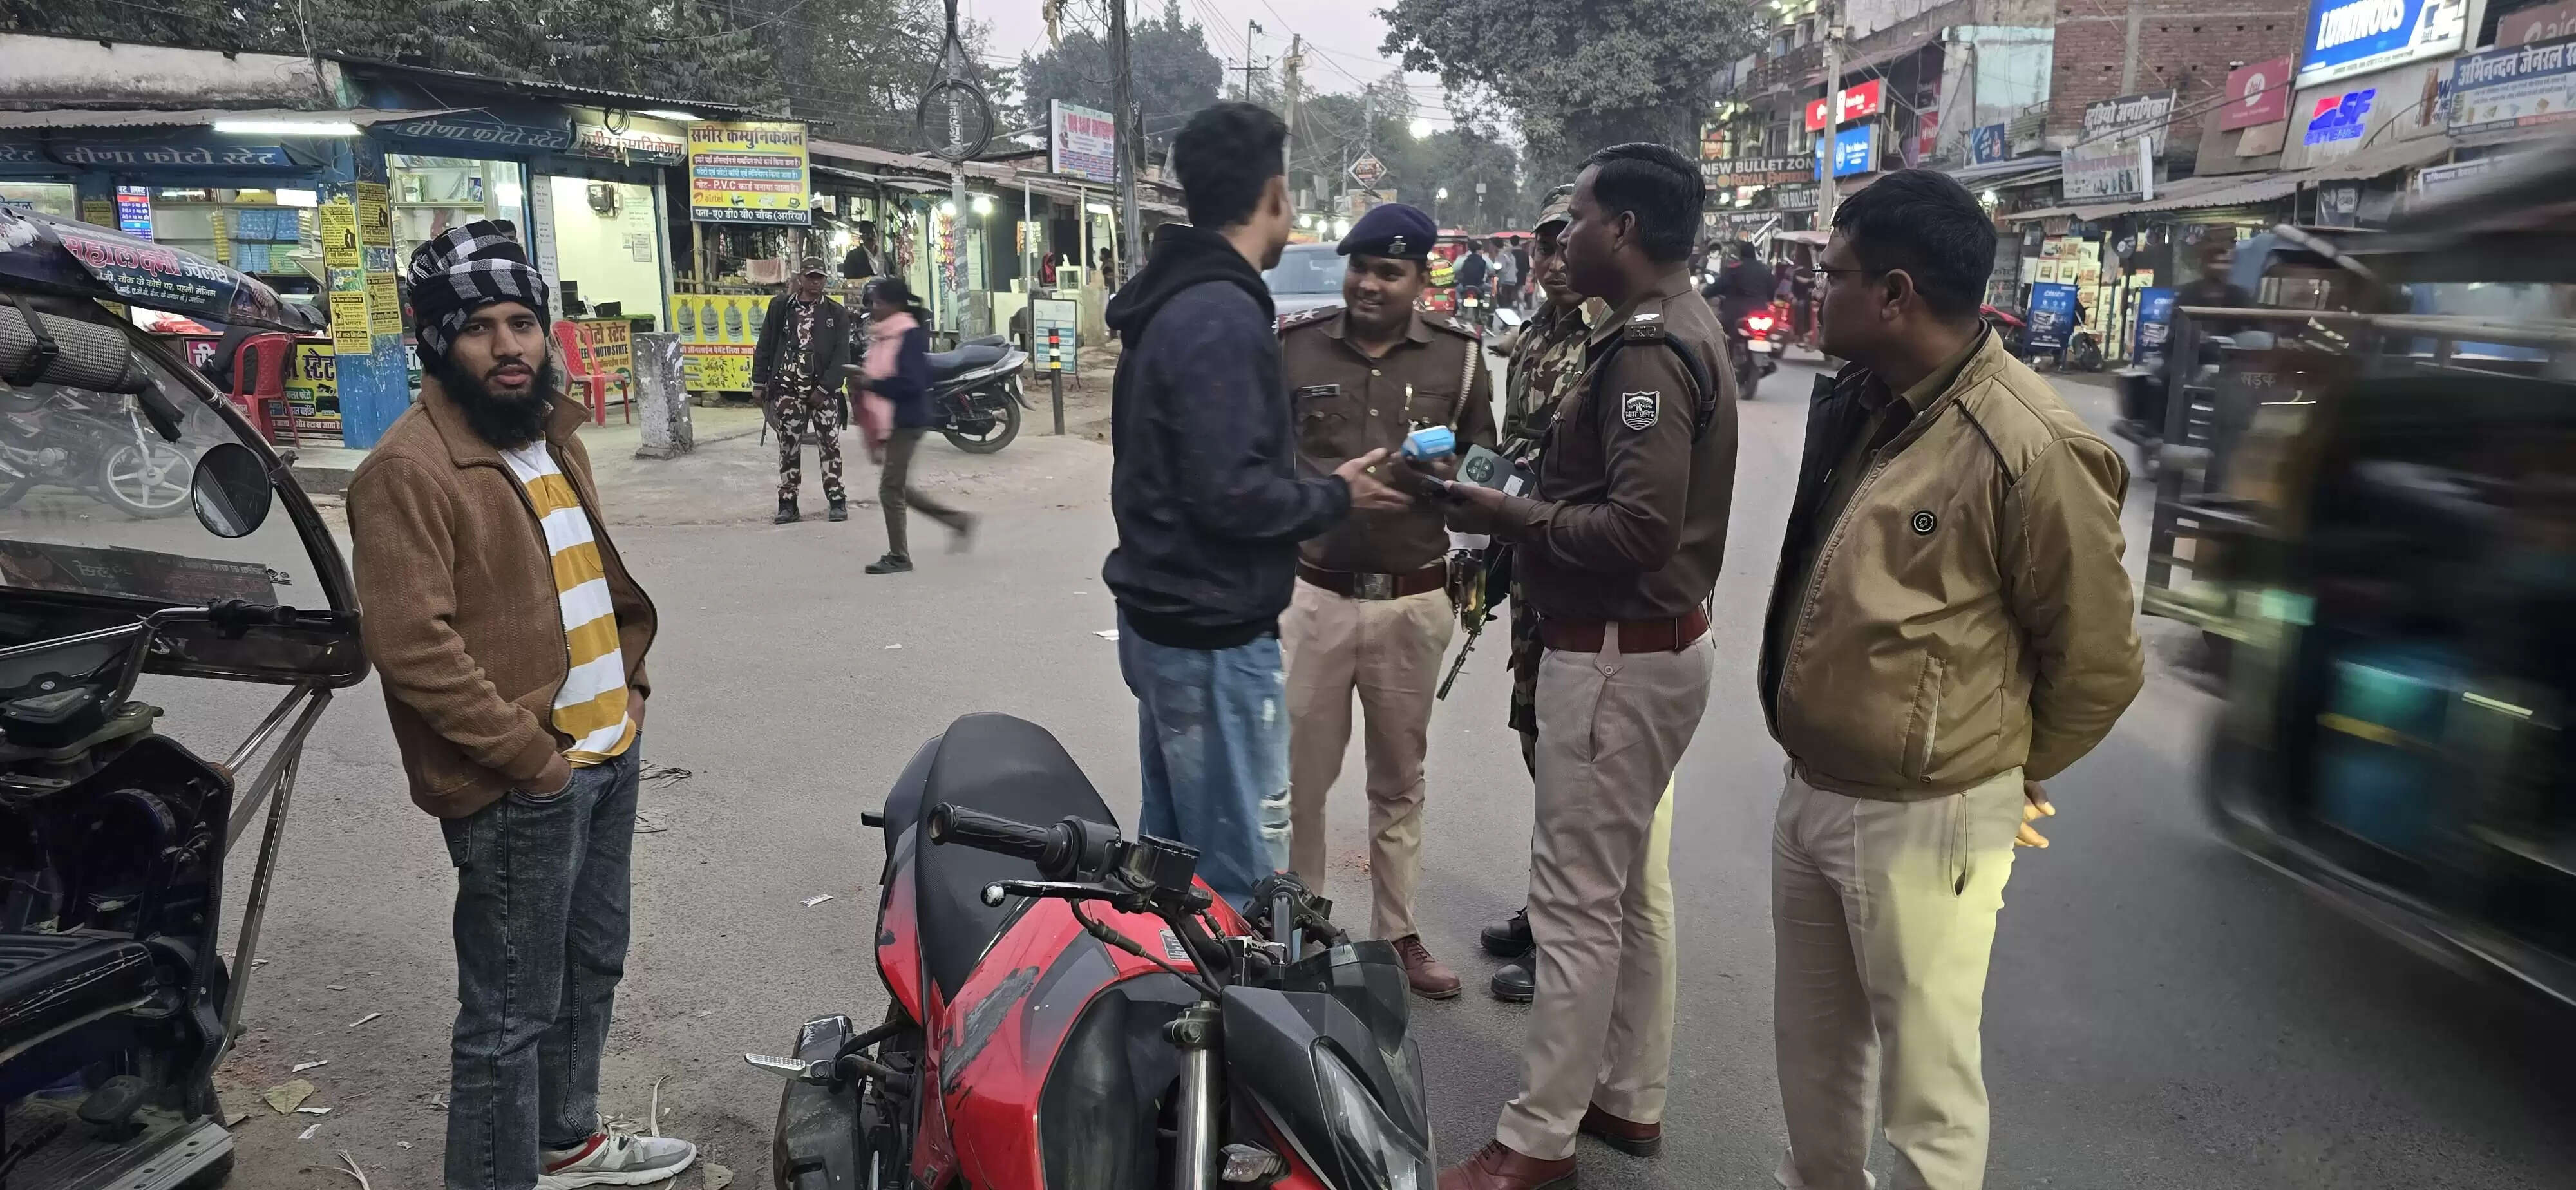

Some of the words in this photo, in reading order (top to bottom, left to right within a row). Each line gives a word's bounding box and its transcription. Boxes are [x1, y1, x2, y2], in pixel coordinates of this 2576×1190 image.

[2316, 0, 2405, 50] LUMINOUS
[2458, 53, 2519, 86] अभिनन्दन
[2519, 44, 2566, 73] जेनरल
[407, 120, 471, 138] वीणा
[473, 126, 526, 145] फोटो
[528, 131, 565, 149] स्टेट
[691, 125, 723, 142] समीर
[66, 145, 135, 165] वीणा
[144, 147, 213, 165] फोटो
[222, 147, 276, 165] स्टेट
[1701, 162, 1732, 175] NEW
[1736, 158, 1785, 173] BULLET
[1786, 158, 1815, 170] ZON
[713, 180, 736, 190] P.V.C
[1730, 173, 1765, 187] ROYAL
[705, 193, 724, 203] airtel
[64, 236, 182, 277] महालक्ष्मी
[137, 275, 144, 285] के
[176, 283, 194, 294] पहली
[606, 323, 626, 343] स्टेट
[612, 344, 628, 355] STATE
[303, 348, 336, 381] स्टेट
[2240, 372, 2277, 389] सड़क
